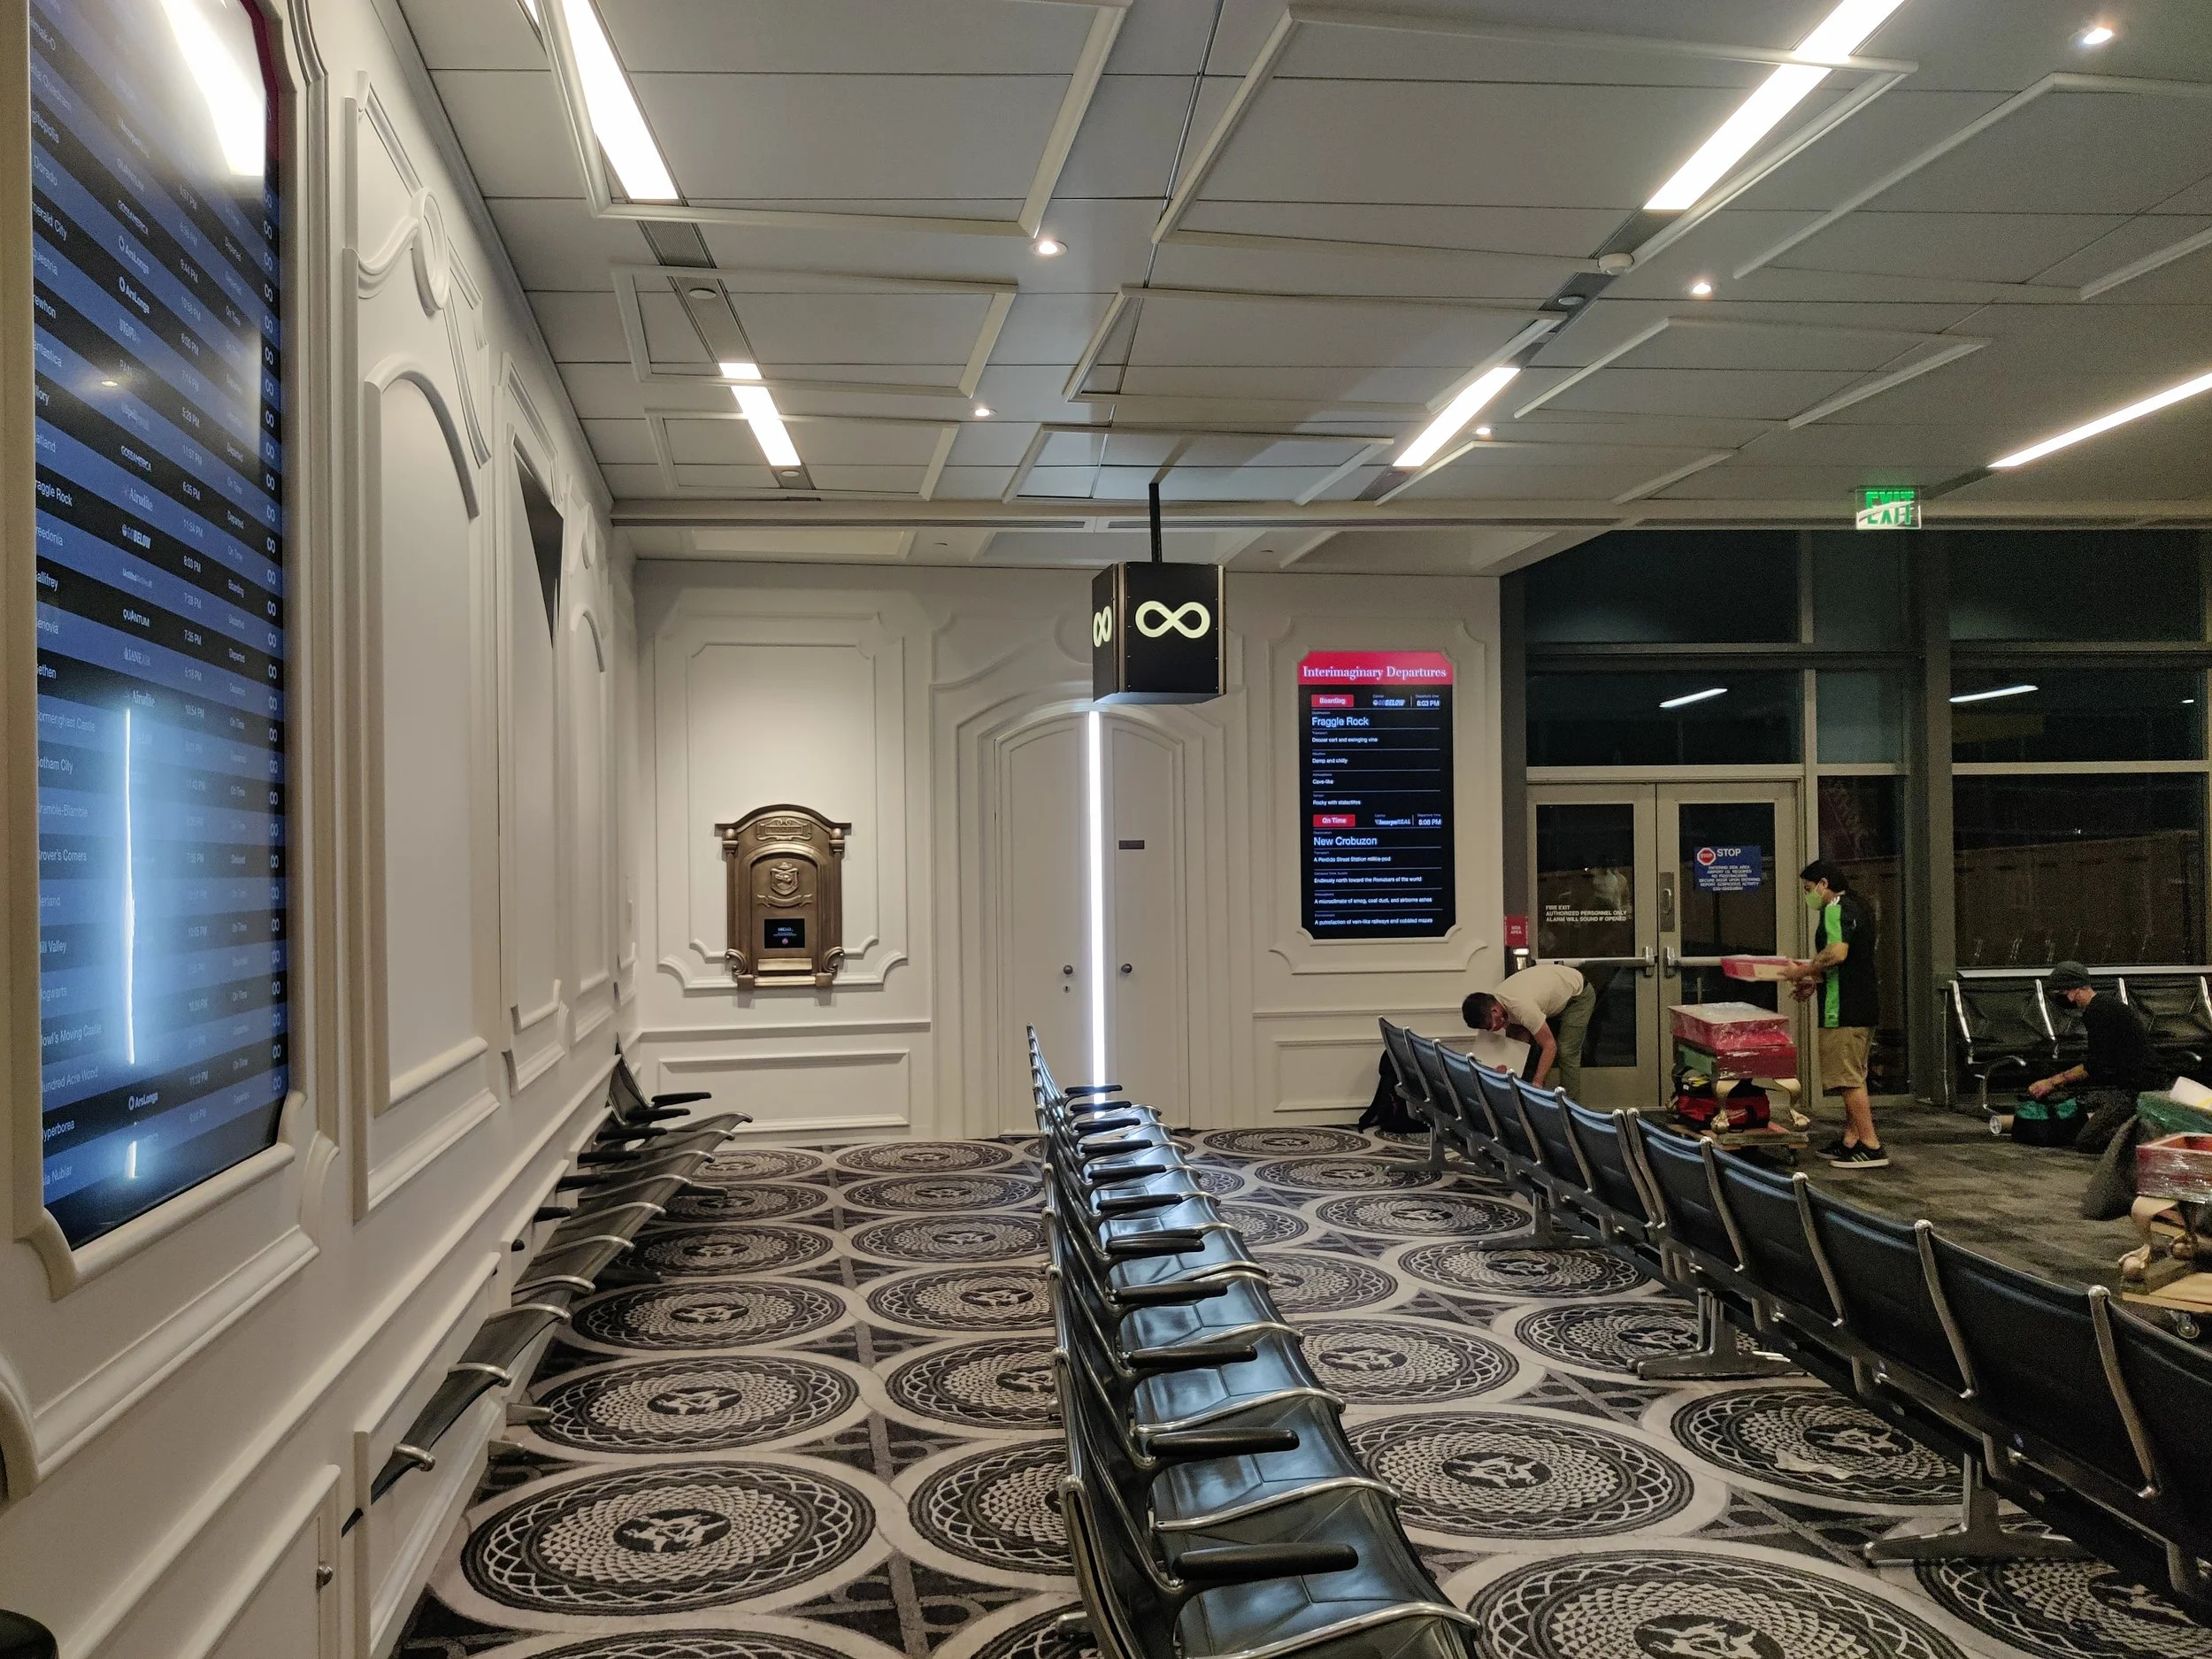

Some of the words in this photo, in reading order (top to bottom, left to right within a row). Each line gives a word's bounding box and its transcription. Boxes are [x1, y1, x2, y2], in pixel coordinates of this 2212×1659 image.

[31, 111, 59, 143] gitopolis
[35, 155, 58, 186] Dorado
[32, 201, 53, 227] merald
[54, 219, 67, 241] City
[33, 294, 56, 319] rewhon
[33, 340, 62, 368] antastica
[36, 434, 56, 453] atland
[35, 479, 55, 498] raggle
[57, 488, 72, 507] Rock
[1866, 491, 1914, 525] EXIT
[36, 526, 63, 546] reedonia
[36, 571, 58, 592] allifrey
[36, 619, 58, 634] enovia
[195, 634, 202, 645] PM
[36, 665, 56, 679] ethen
[1303, 666, 1383, 680] Interimaginary
[1386, 666, 1447, 680] Departures
[38, 711, 75, 729] ormenghast
[1312, 717, 1344, 727] Fraggle
[1346, 717, 1369, 726] Rock
[61, 759, 73, 774] City
[1313, 837, 1333, 846] New
[1335, 837, 1377, 845] Crobuzon
[39, 849, 61, 861] rover's
[1717, 849, 1741, 857] STOP
[40, 895, 61, 906] erland
[48, 939, 66, 954] Valley
[41, 987, 67, 1001] ogwarts
[60, 1027, 82, 1042] Moving
[84, 1025, 102, 1037] Castle
[42, 1075, 65, 1092] undred
[66, 1073, 81, 1086] Acre
[82, 1066, 98, 1080] Wood
[43, 1120, 75, 1142] yperborea
[52, 1166, 72, 1182] Nublar
